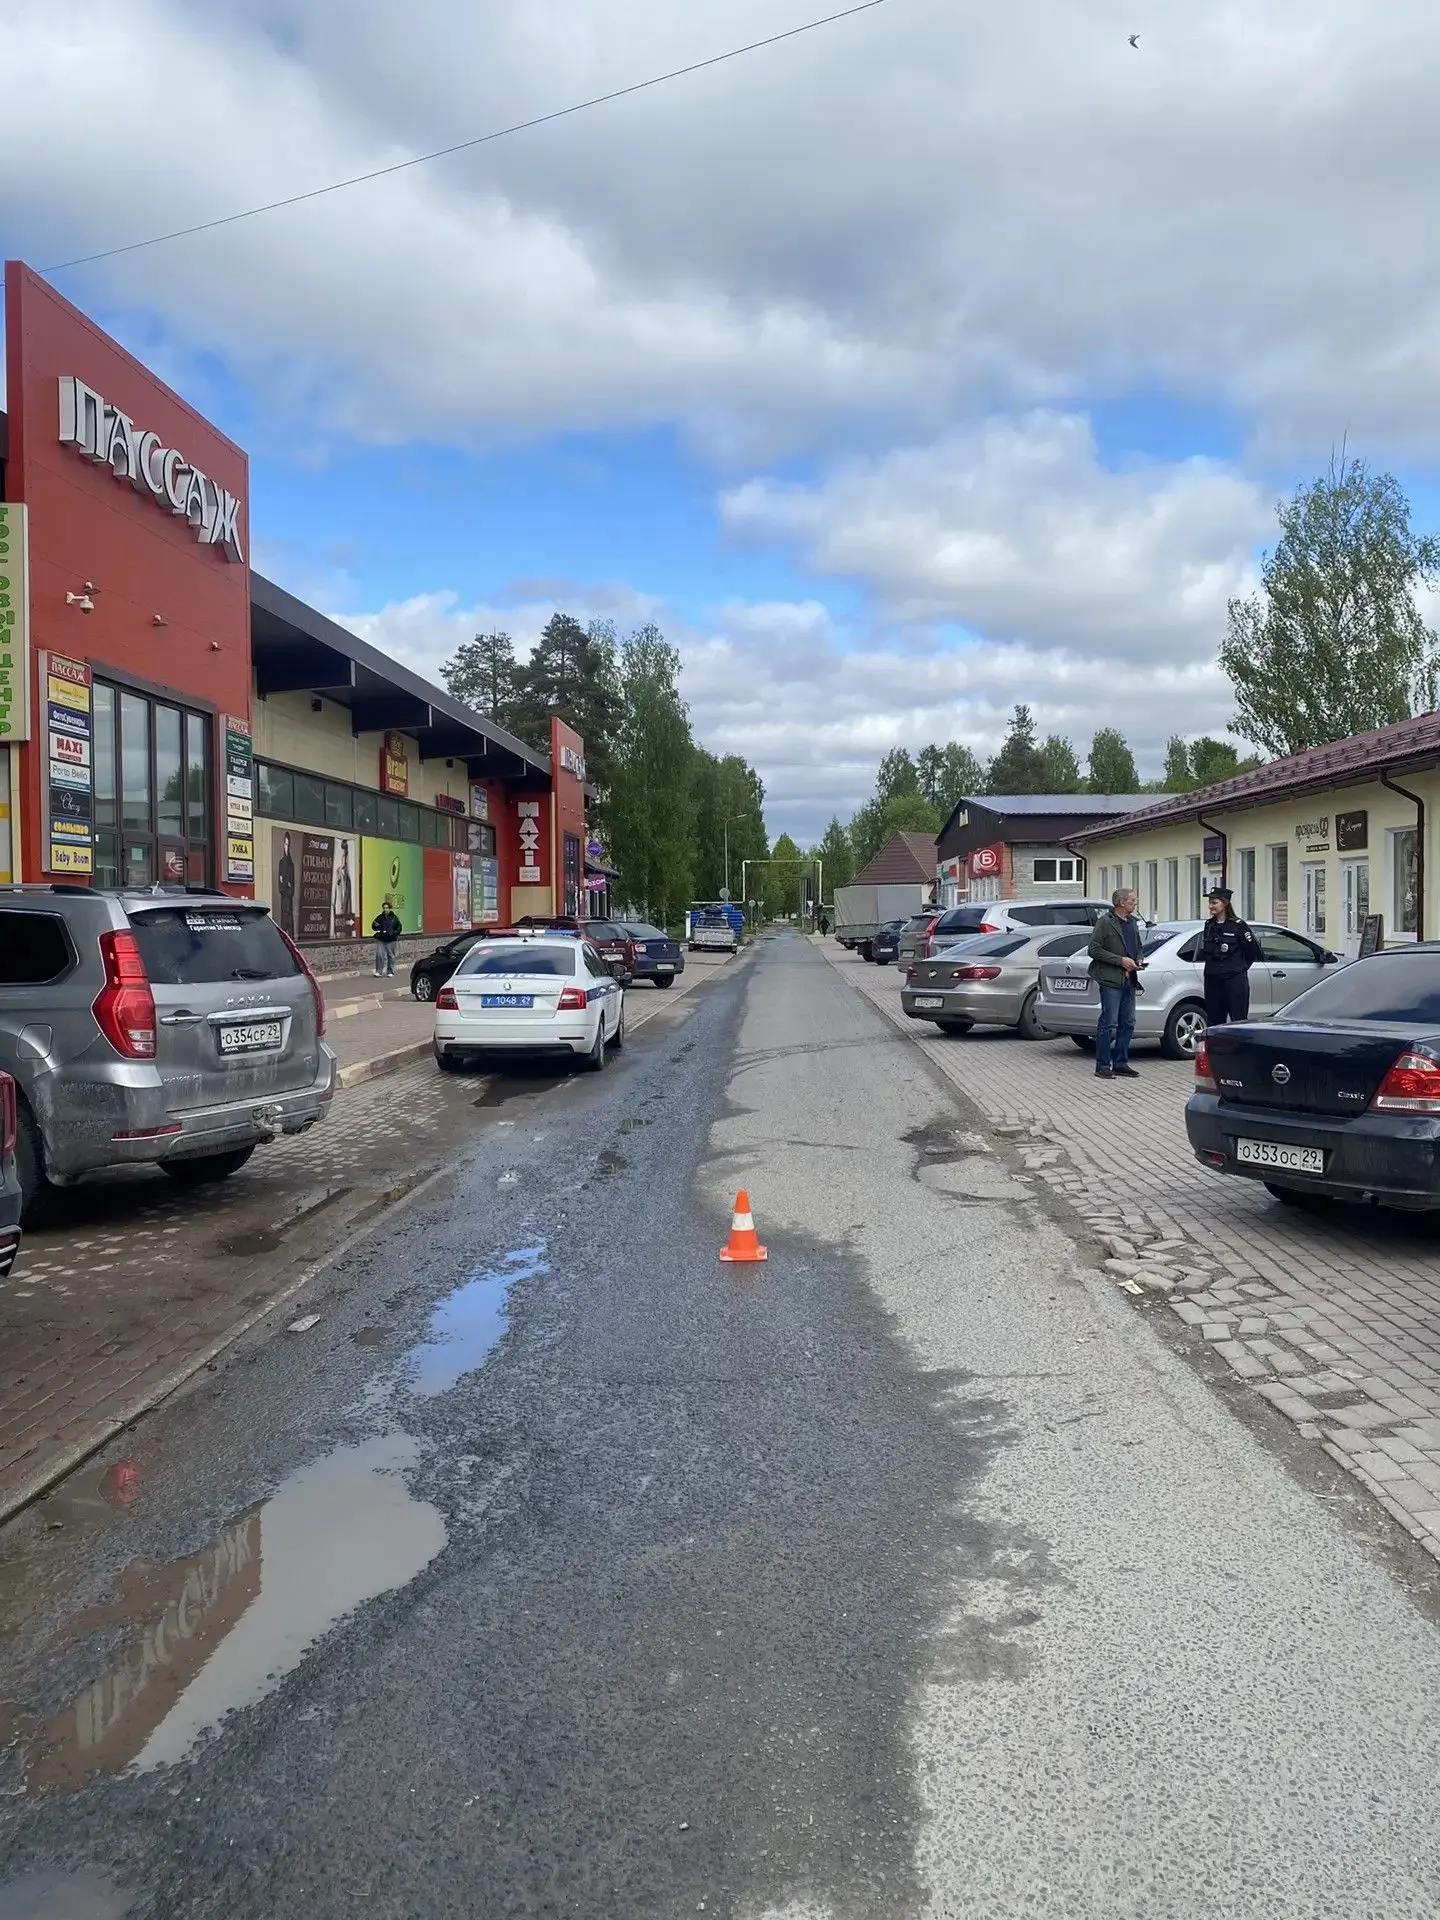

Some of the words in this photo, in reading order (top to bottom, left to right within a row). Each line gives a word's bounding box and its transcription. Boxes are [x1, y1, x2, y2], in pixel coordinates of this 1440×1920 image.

[57, 376, 243, 563] ПАССАЖ
[52, 661, 85, 682] ПАССАЖ
[53, 765, 70, 777] Porto
[71, 769, 88, 780] Bello
[55, 849, 71, 866] Baby
[73, 852, 89, 865] Boom
[496, 996, 517, 1005] 1048
[521, 996, 531, 1005] 29
[225, 1027, 266, 1045] О354СР
[267, 1024, 278, 1036] 29
[1337, 1090, 1365, 1100] Classic
[1242, 1143, 1298, 1166] О353ОС
[1302, 1149, 1318, 1164] 29
